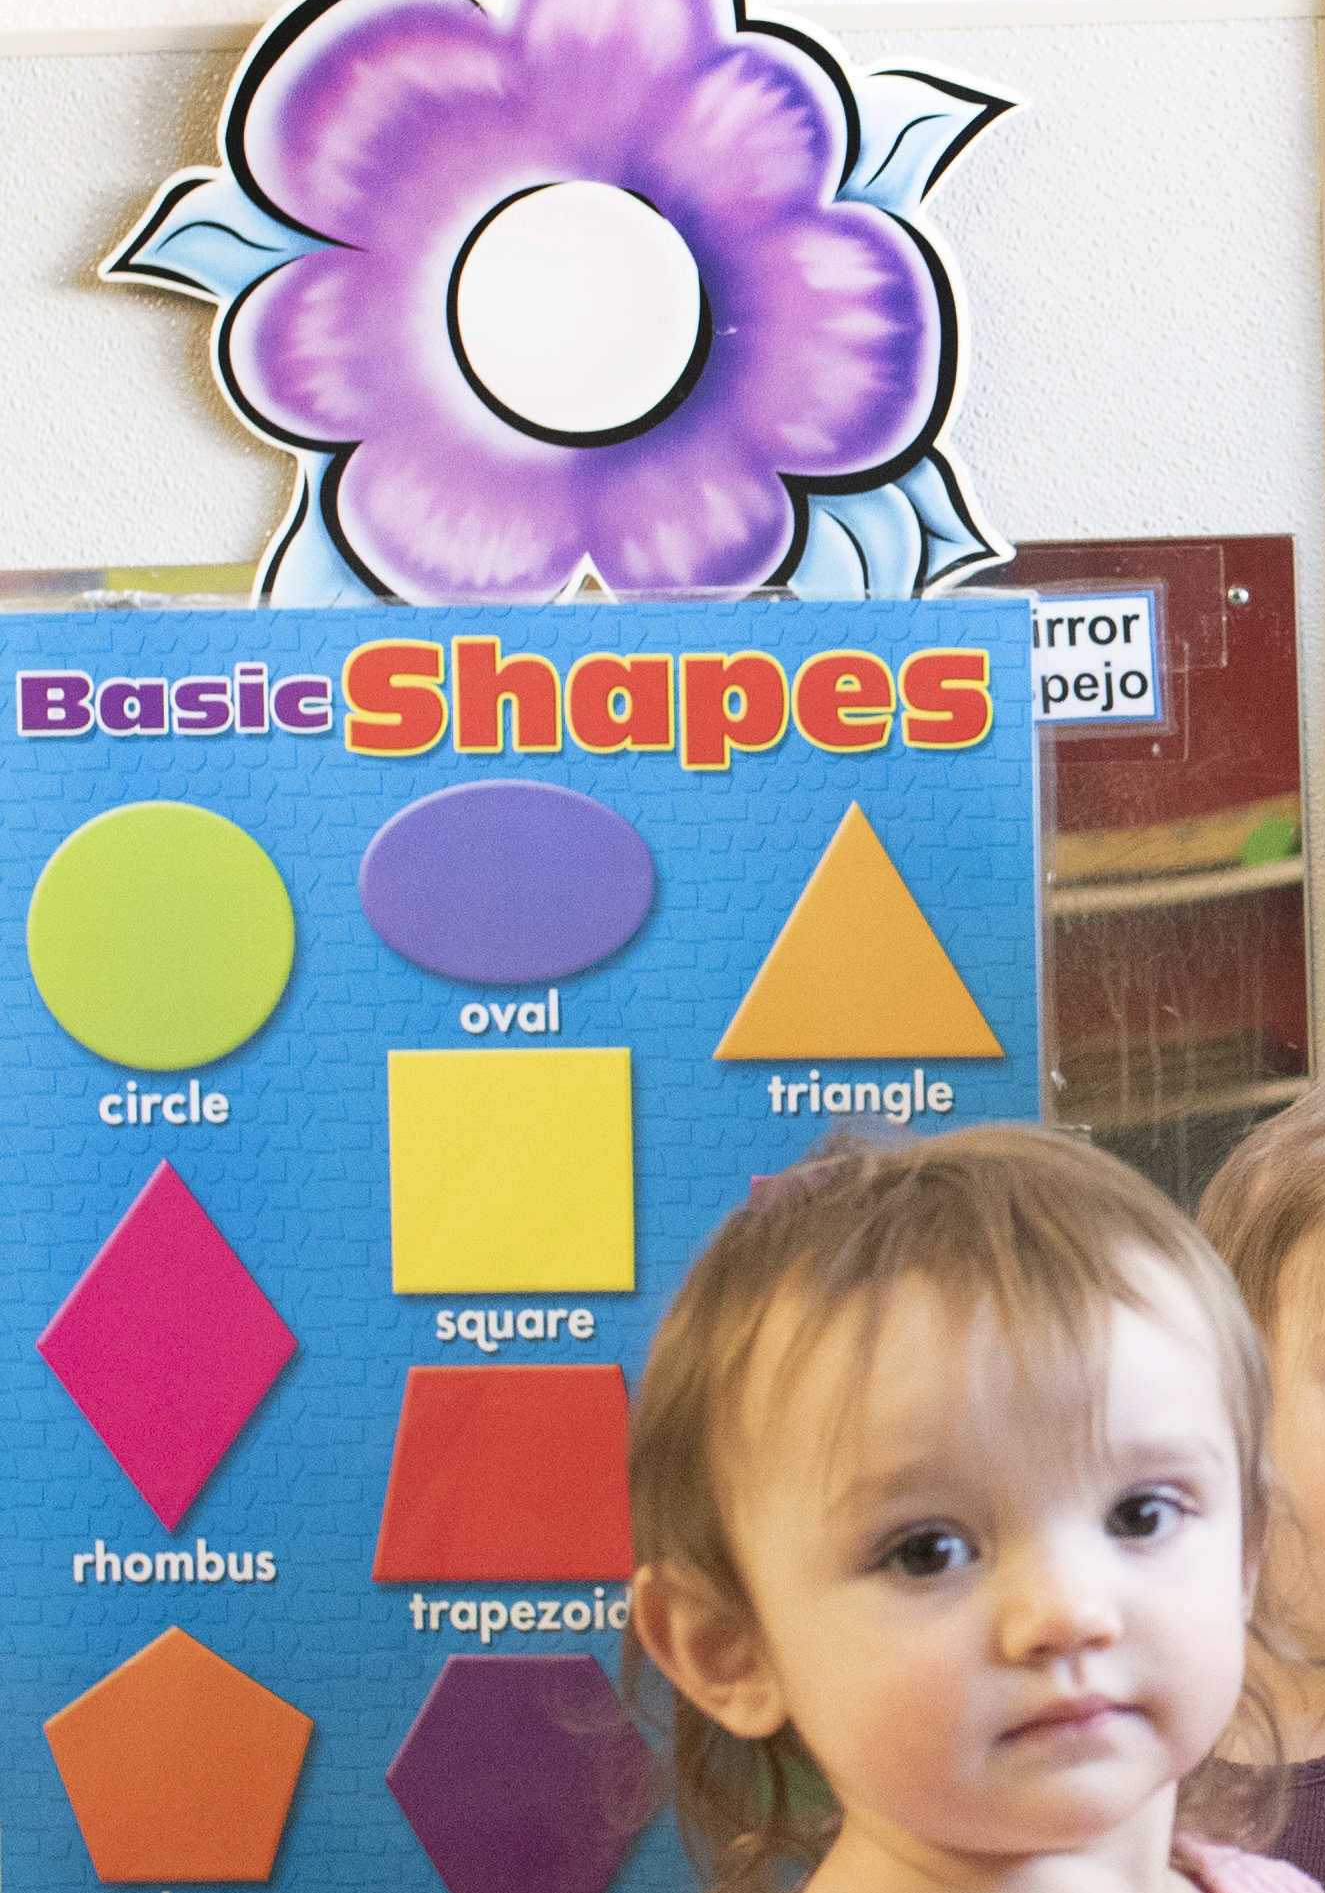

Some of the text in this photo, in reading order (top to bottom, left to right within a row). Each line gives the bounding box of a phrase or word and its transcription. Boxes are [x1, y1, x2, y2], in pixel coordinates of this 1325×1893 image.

[1033, 609, 1140, 648] irror
[17, 634, 992, 771] Basic Shapes
[1040, 661, 1148, 714] pejo
[459, 990, 561, 1034] oval
[98, 1080, 230, 1126] circle
[767, 1070, 955, 1123] triangle
[435, 1305, 595, 1351] square
[72, 1539, 277, 1583] rhombus
[410, 1588, 633, 1642] trapezoid
